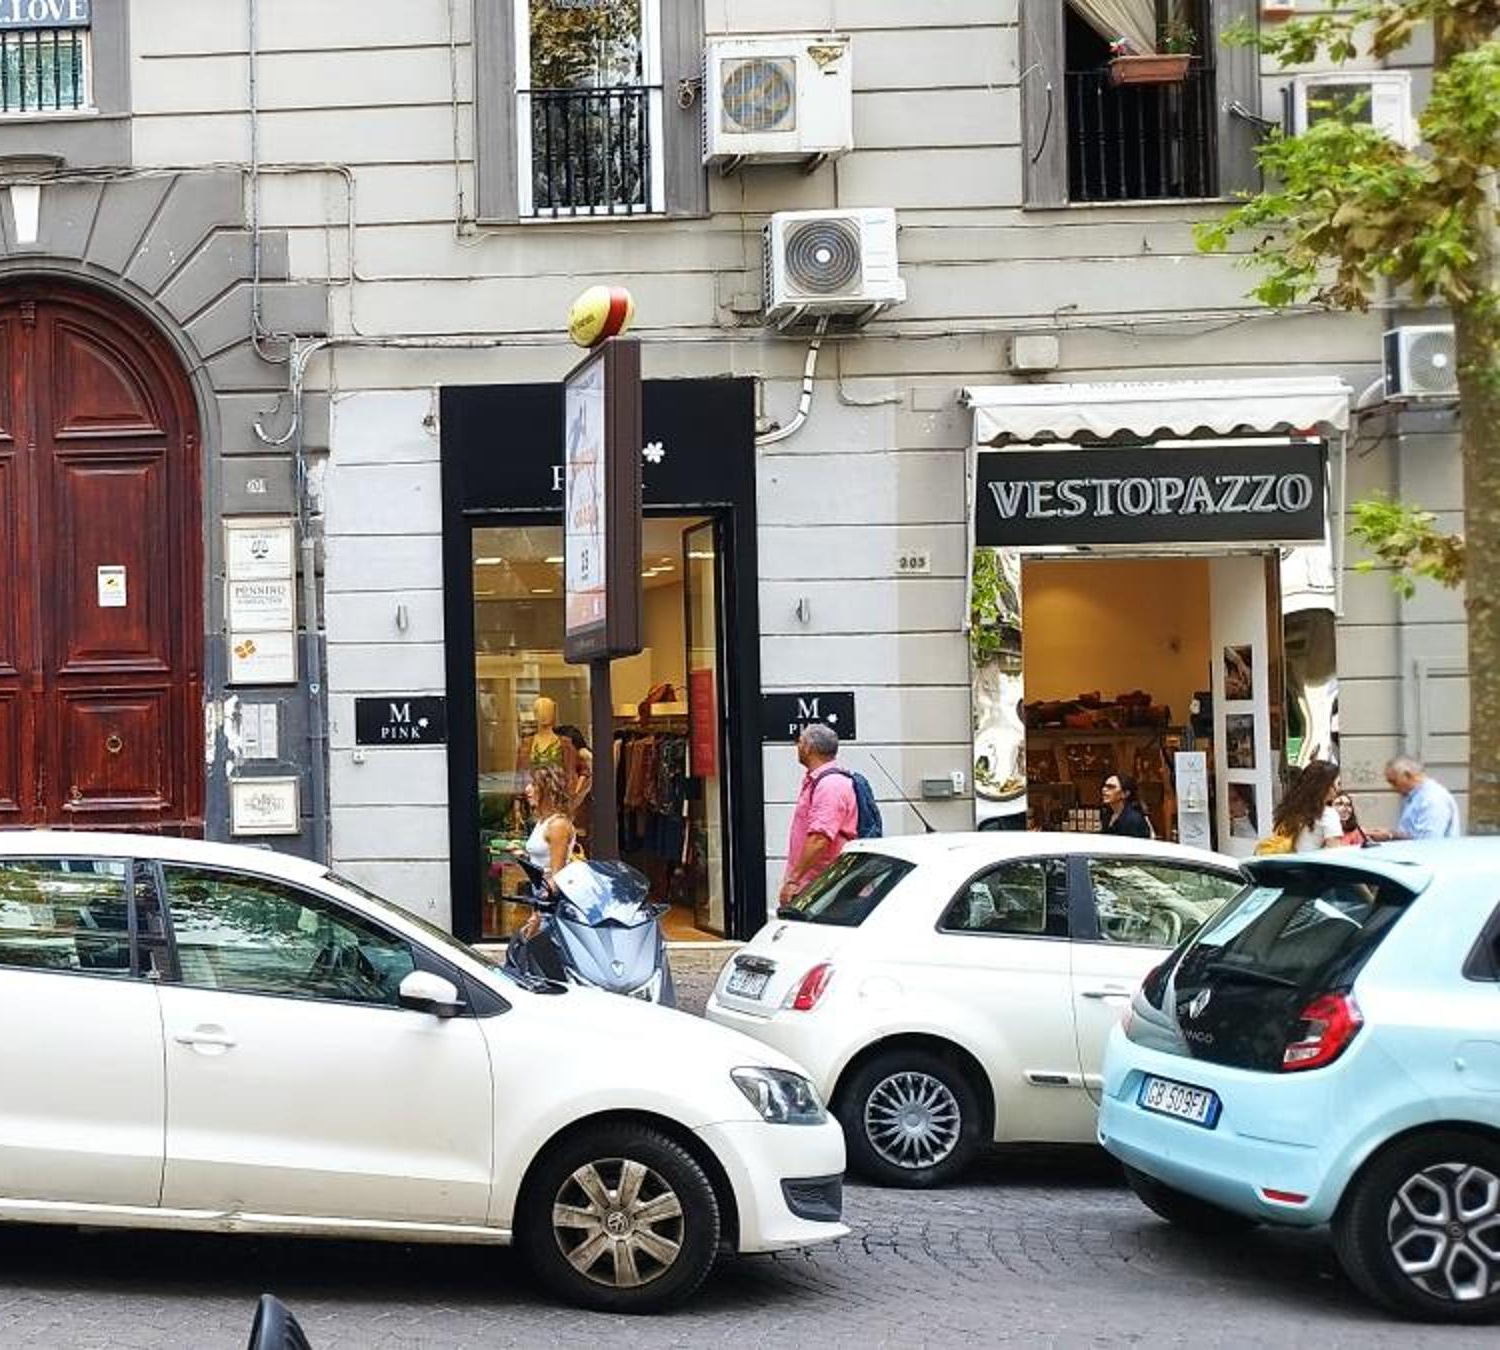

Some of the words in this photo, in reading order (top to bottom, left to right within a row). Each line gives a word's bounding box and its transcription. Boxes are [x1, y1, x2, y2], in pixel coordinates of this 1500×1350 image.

[988, 473, 1313, 519] VESTOPAZZO
[389, 702, 411, 723] M
[797, 697, 821, 719] M
[381, 726, 420, 739] PINK
